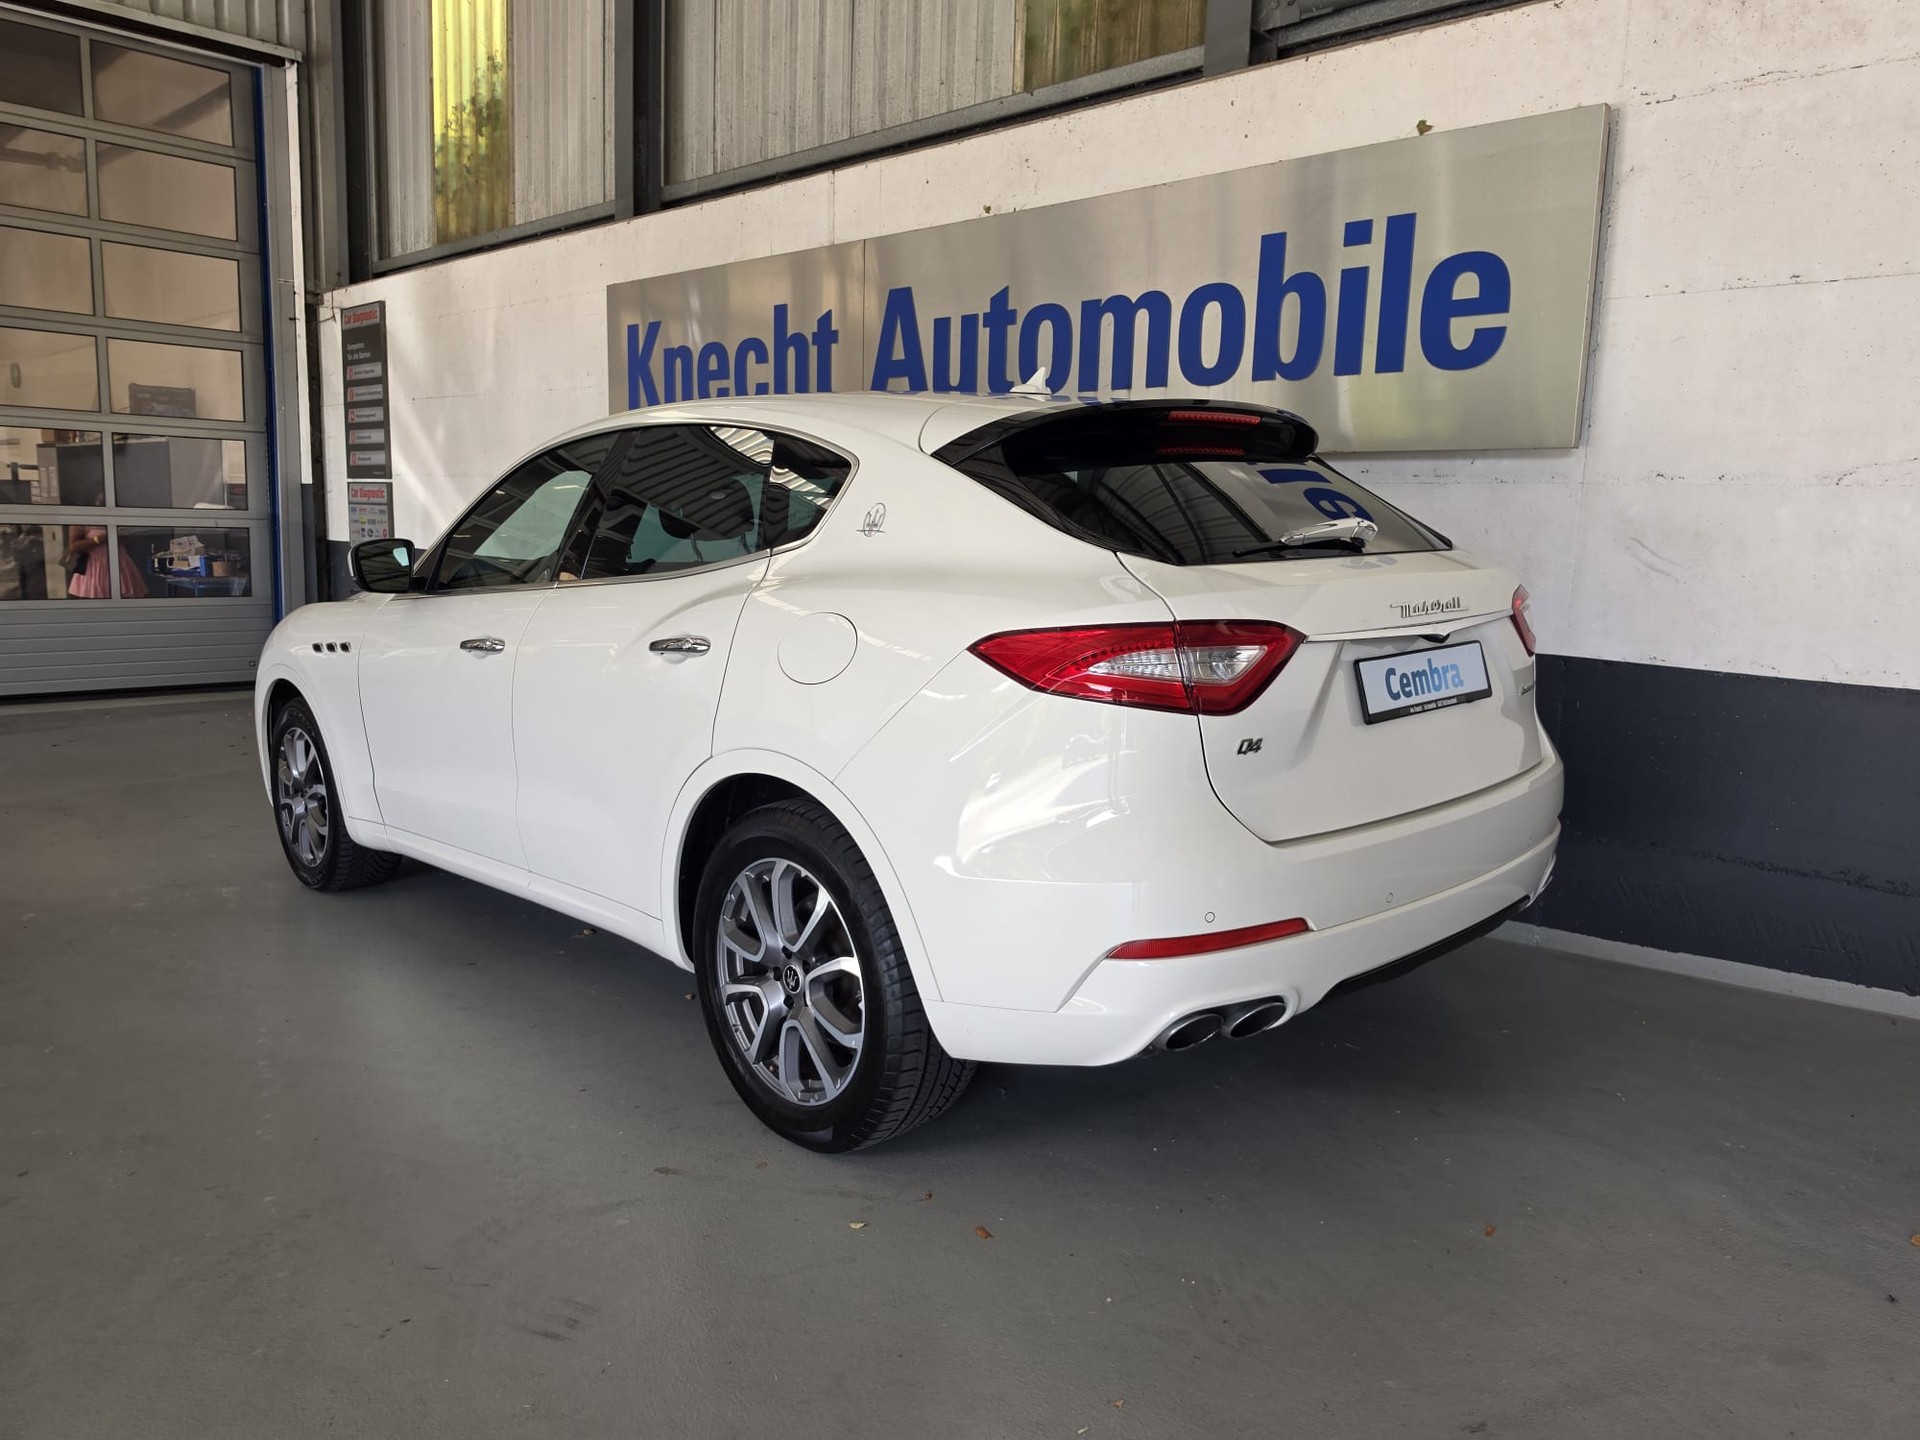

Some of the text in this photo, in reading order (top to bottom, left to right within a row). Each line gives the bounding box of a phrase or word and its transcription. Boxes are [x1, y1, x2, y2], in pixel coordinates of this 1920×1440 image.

[627, 213, 1511, 410] Knecht Automobile
[351, 486, 385, 501] Car Diagnostic
[1385, 658, 1464, 701] Cembra
[1237, 736, 1263, 756] Q4
